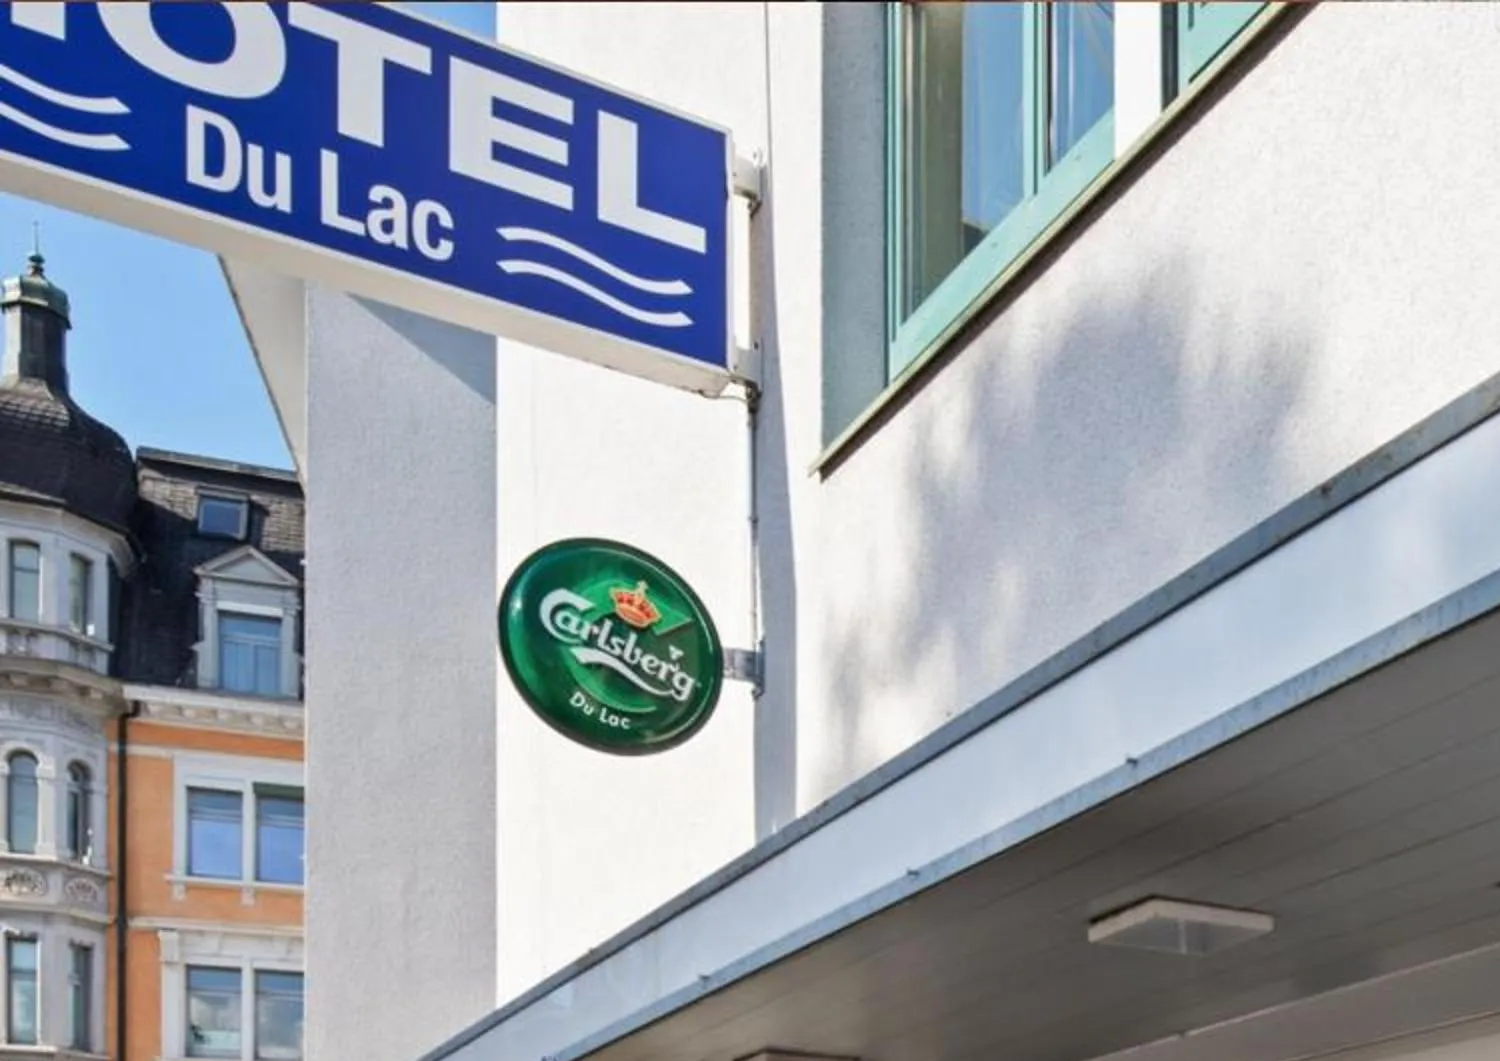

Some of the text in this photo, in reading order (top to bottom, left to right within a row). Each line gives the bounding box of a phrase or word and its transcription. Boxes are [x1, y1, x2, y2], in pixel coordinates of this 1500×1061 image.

[11, 2, 706, 254] OTEL
[186, 103, 455, 261] Du Lac
[539, 588, 696, 701] Carlsberg
[569, 691, 631, 730] Du Lac
